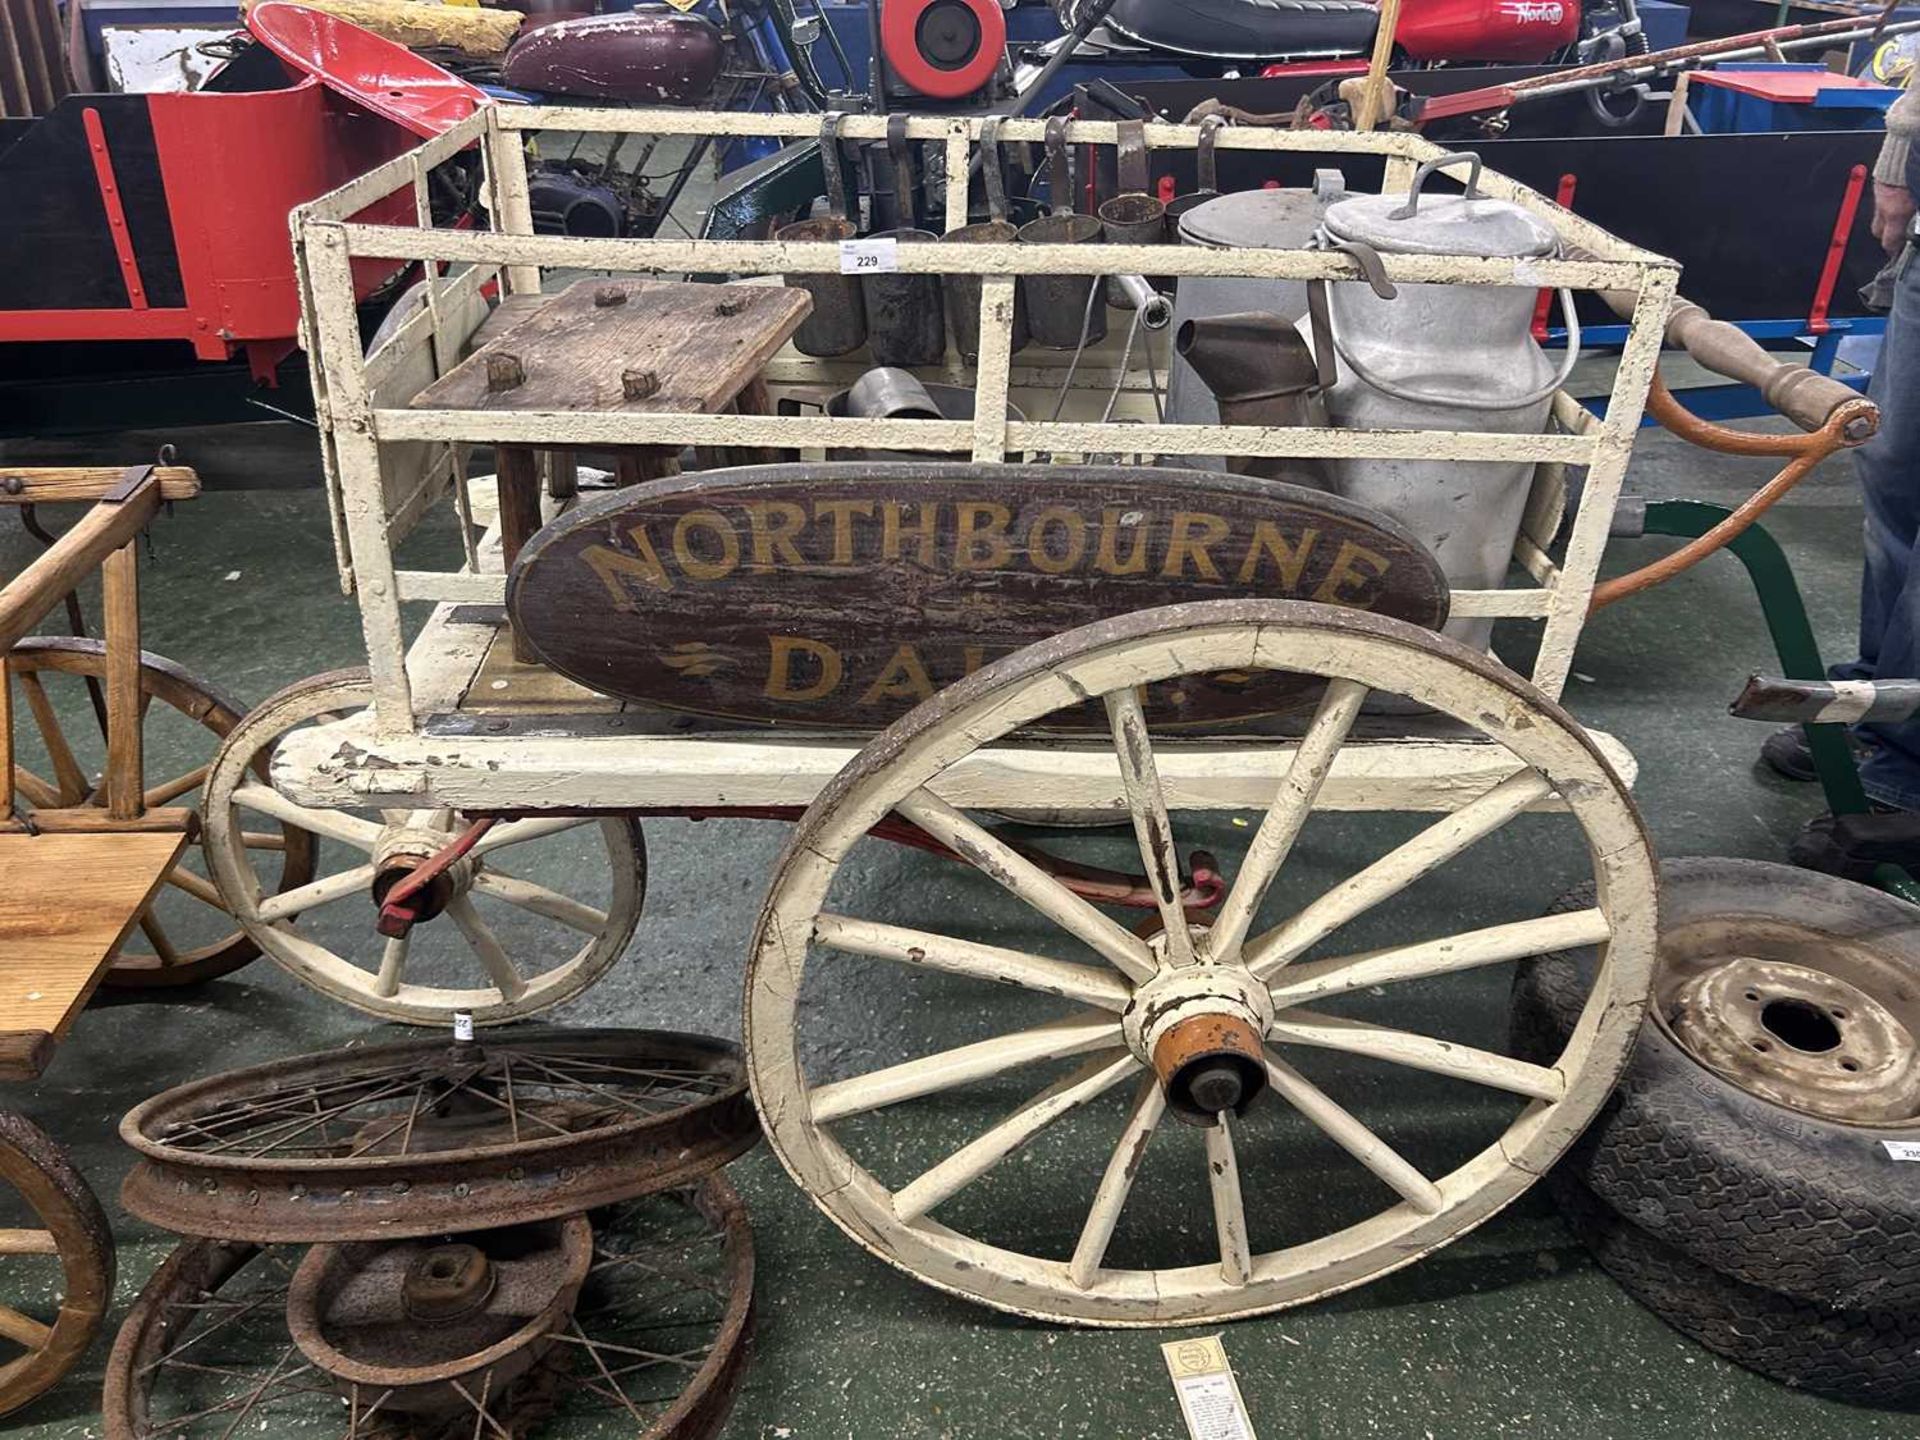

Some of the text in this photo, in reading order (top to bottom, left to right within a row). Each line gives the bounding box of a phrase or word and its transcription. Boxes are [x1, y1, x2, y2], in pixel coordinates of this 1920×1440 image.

[1515, 1, 1563, 25] Norton
[857, 255, 878, 267] 229
[579, 500, 1391, 609] NORTHBOURNE
